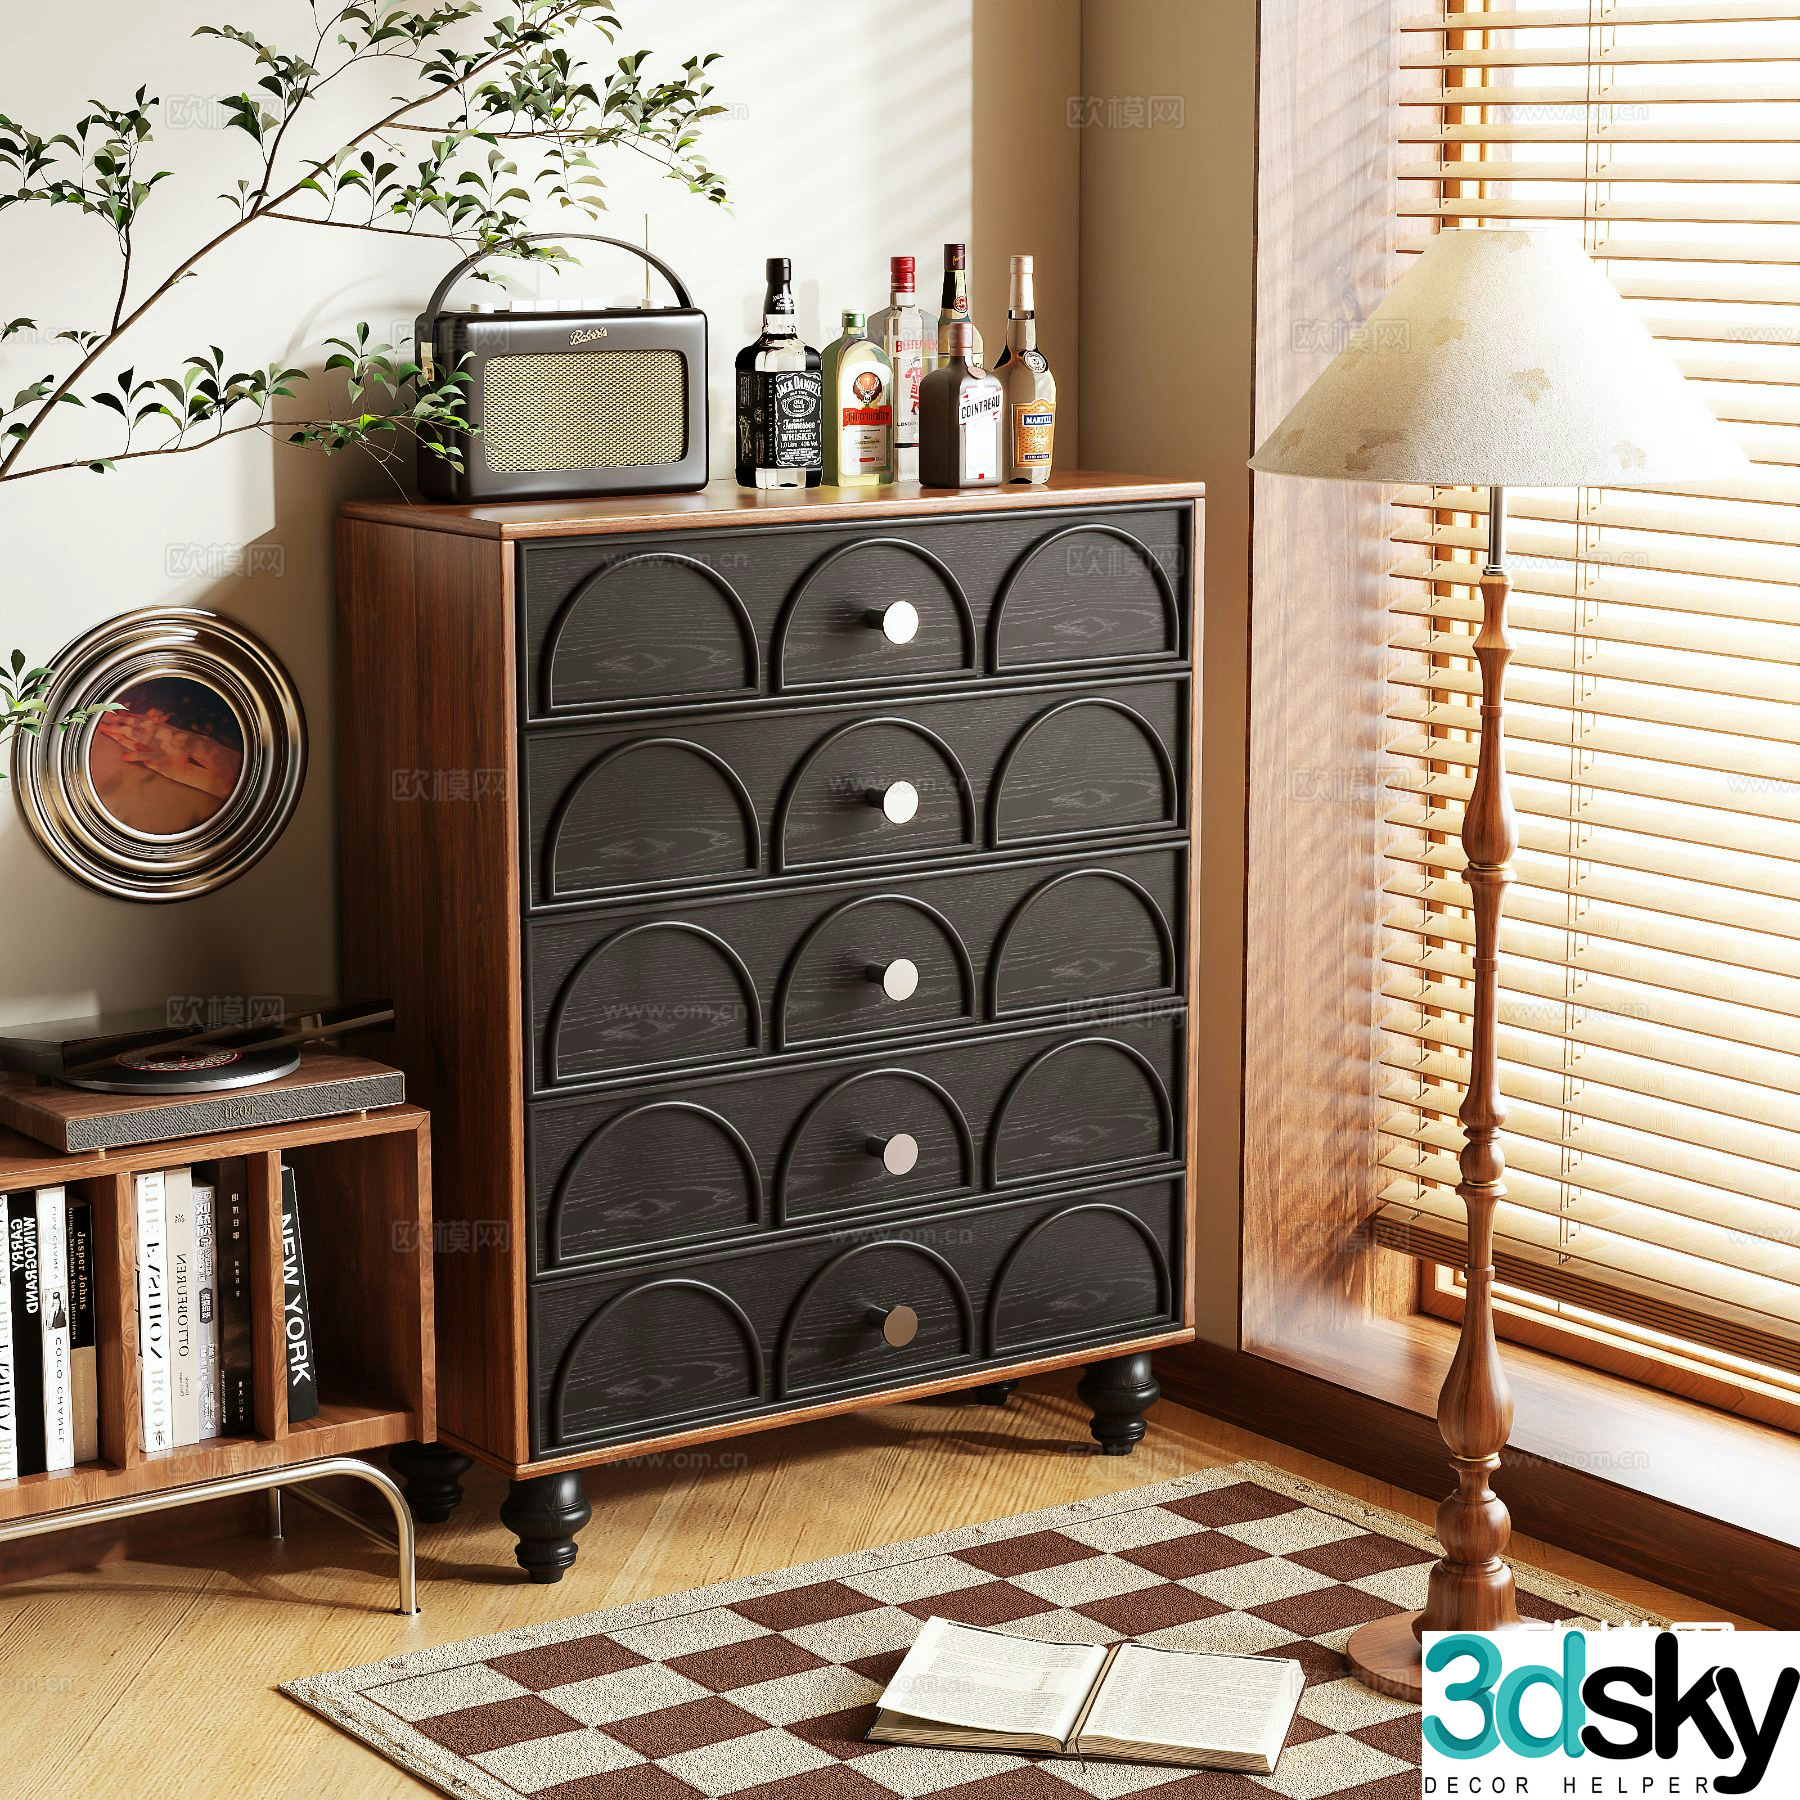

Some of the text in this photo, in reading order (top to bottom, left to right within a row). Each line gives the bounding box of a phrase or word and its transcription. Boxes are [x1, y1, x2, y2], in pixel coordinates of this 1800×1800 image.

[569, 326, 608, 346] Roberts
[896, 339, 937, 353] BEEFEATER
[961, 394, 1001, 419] COINTREAU
[780, 432, 817, 442] WHISKEY
[76, 1231, 88, 1310] Jasper Johns
[281, 1213, 311, 1387] NEW YORK
